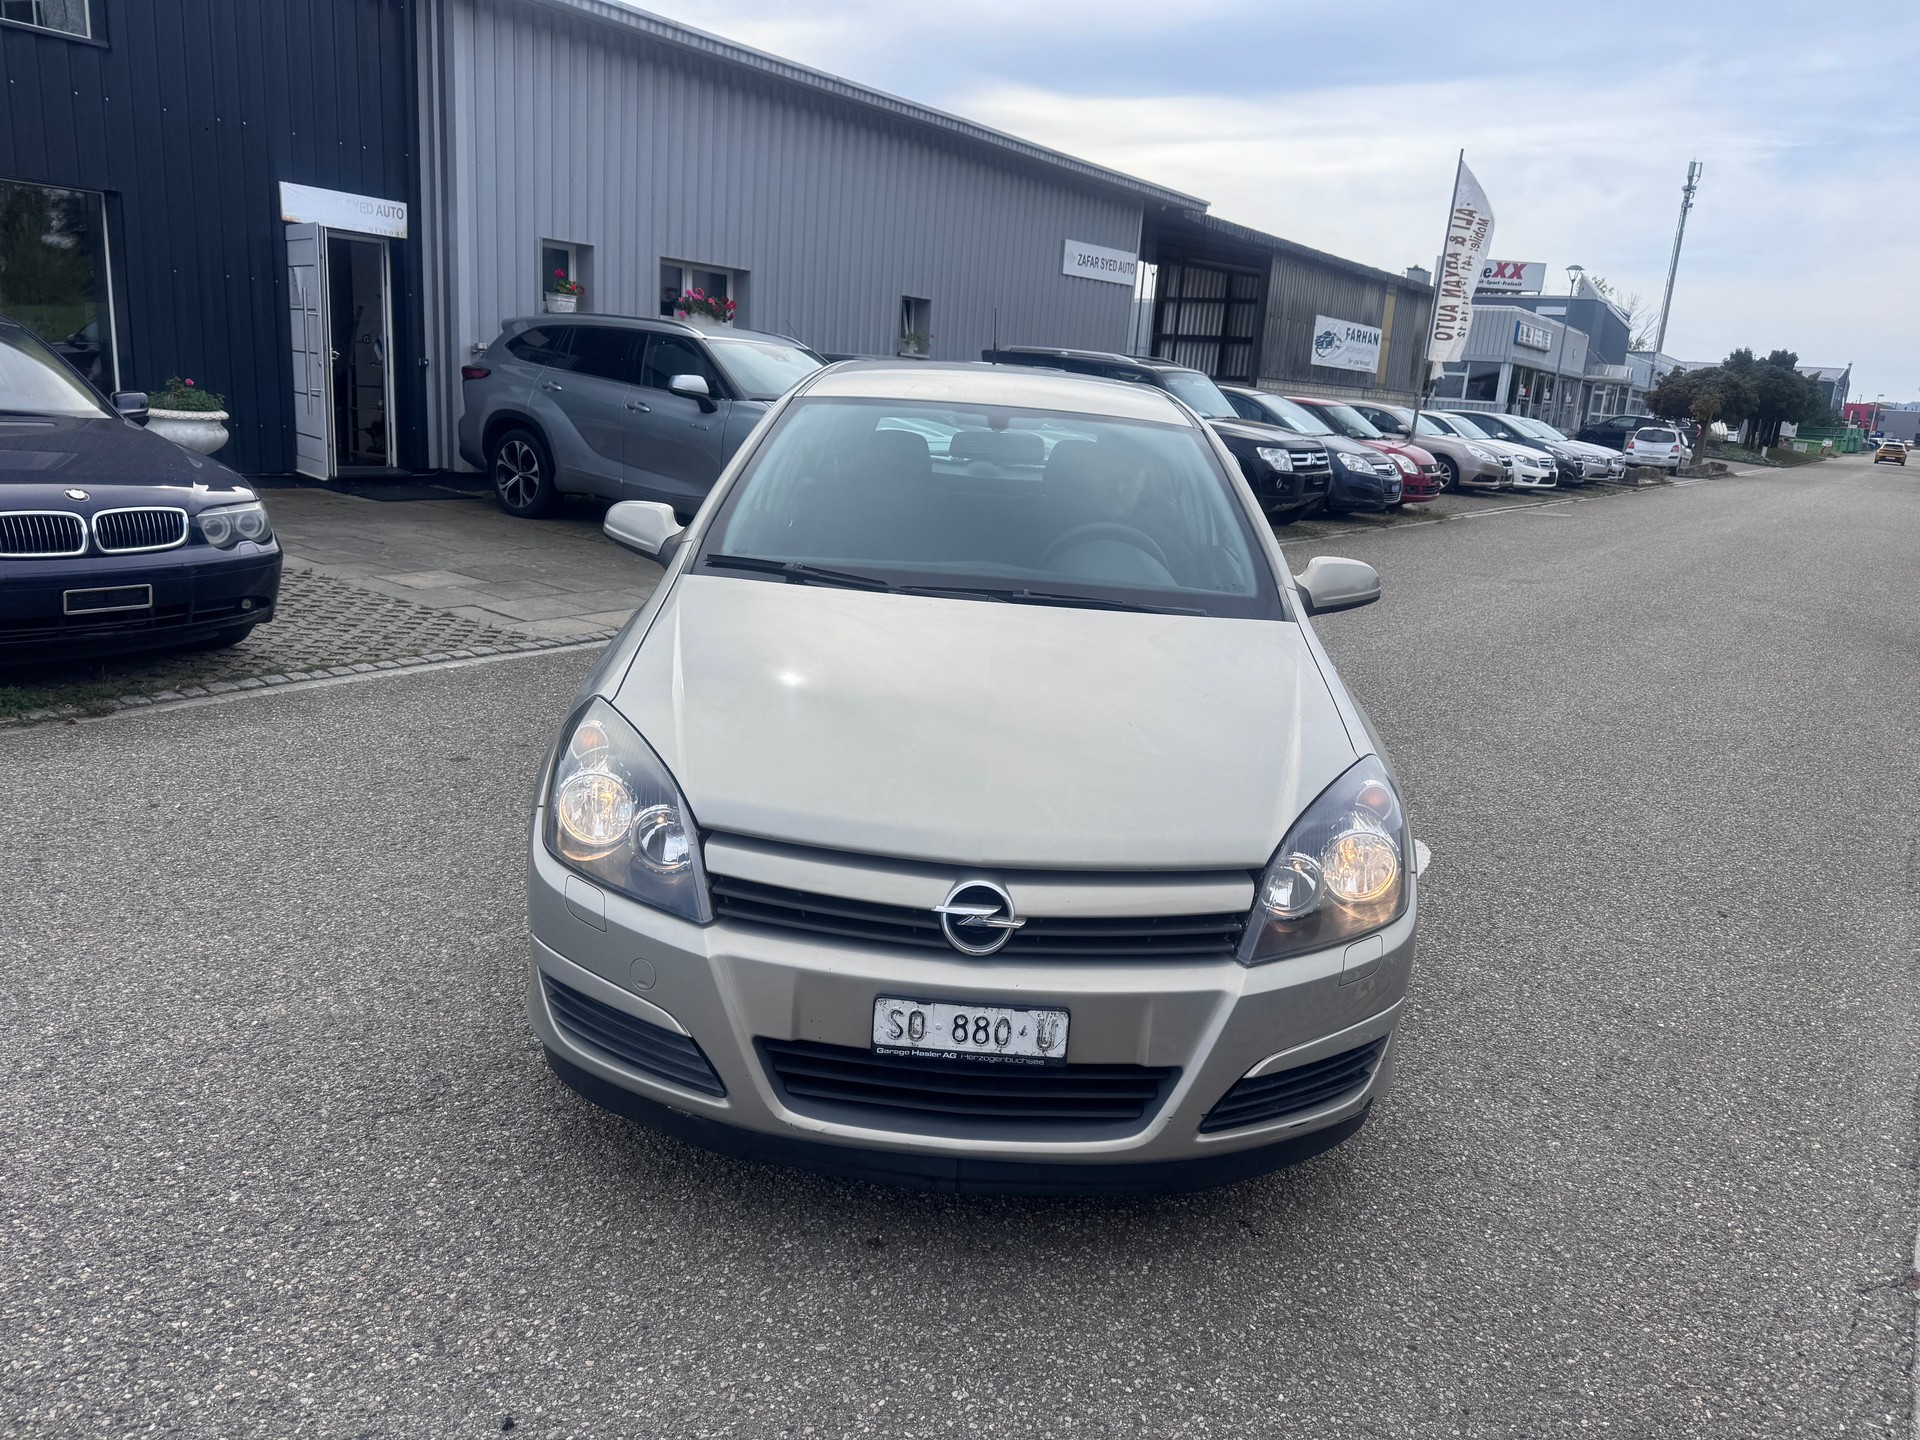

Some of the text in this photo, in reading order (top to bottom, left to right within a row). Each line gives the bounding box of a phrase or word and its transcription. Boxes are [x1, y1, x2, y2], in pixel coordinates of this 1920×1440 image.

[376, 204, 404, 220] AUTO
[1078, 253, 1135, 275] ZAFAR SYED AUTO
[1480, 262, 1527, 280] eXX
[1345, 327, 1380, 346] FARHAN
[951, 1013, 1013, 1048] 880
[876, 1047, 1045, 1066] Garage Hasler AG Herzogenbuchsee
